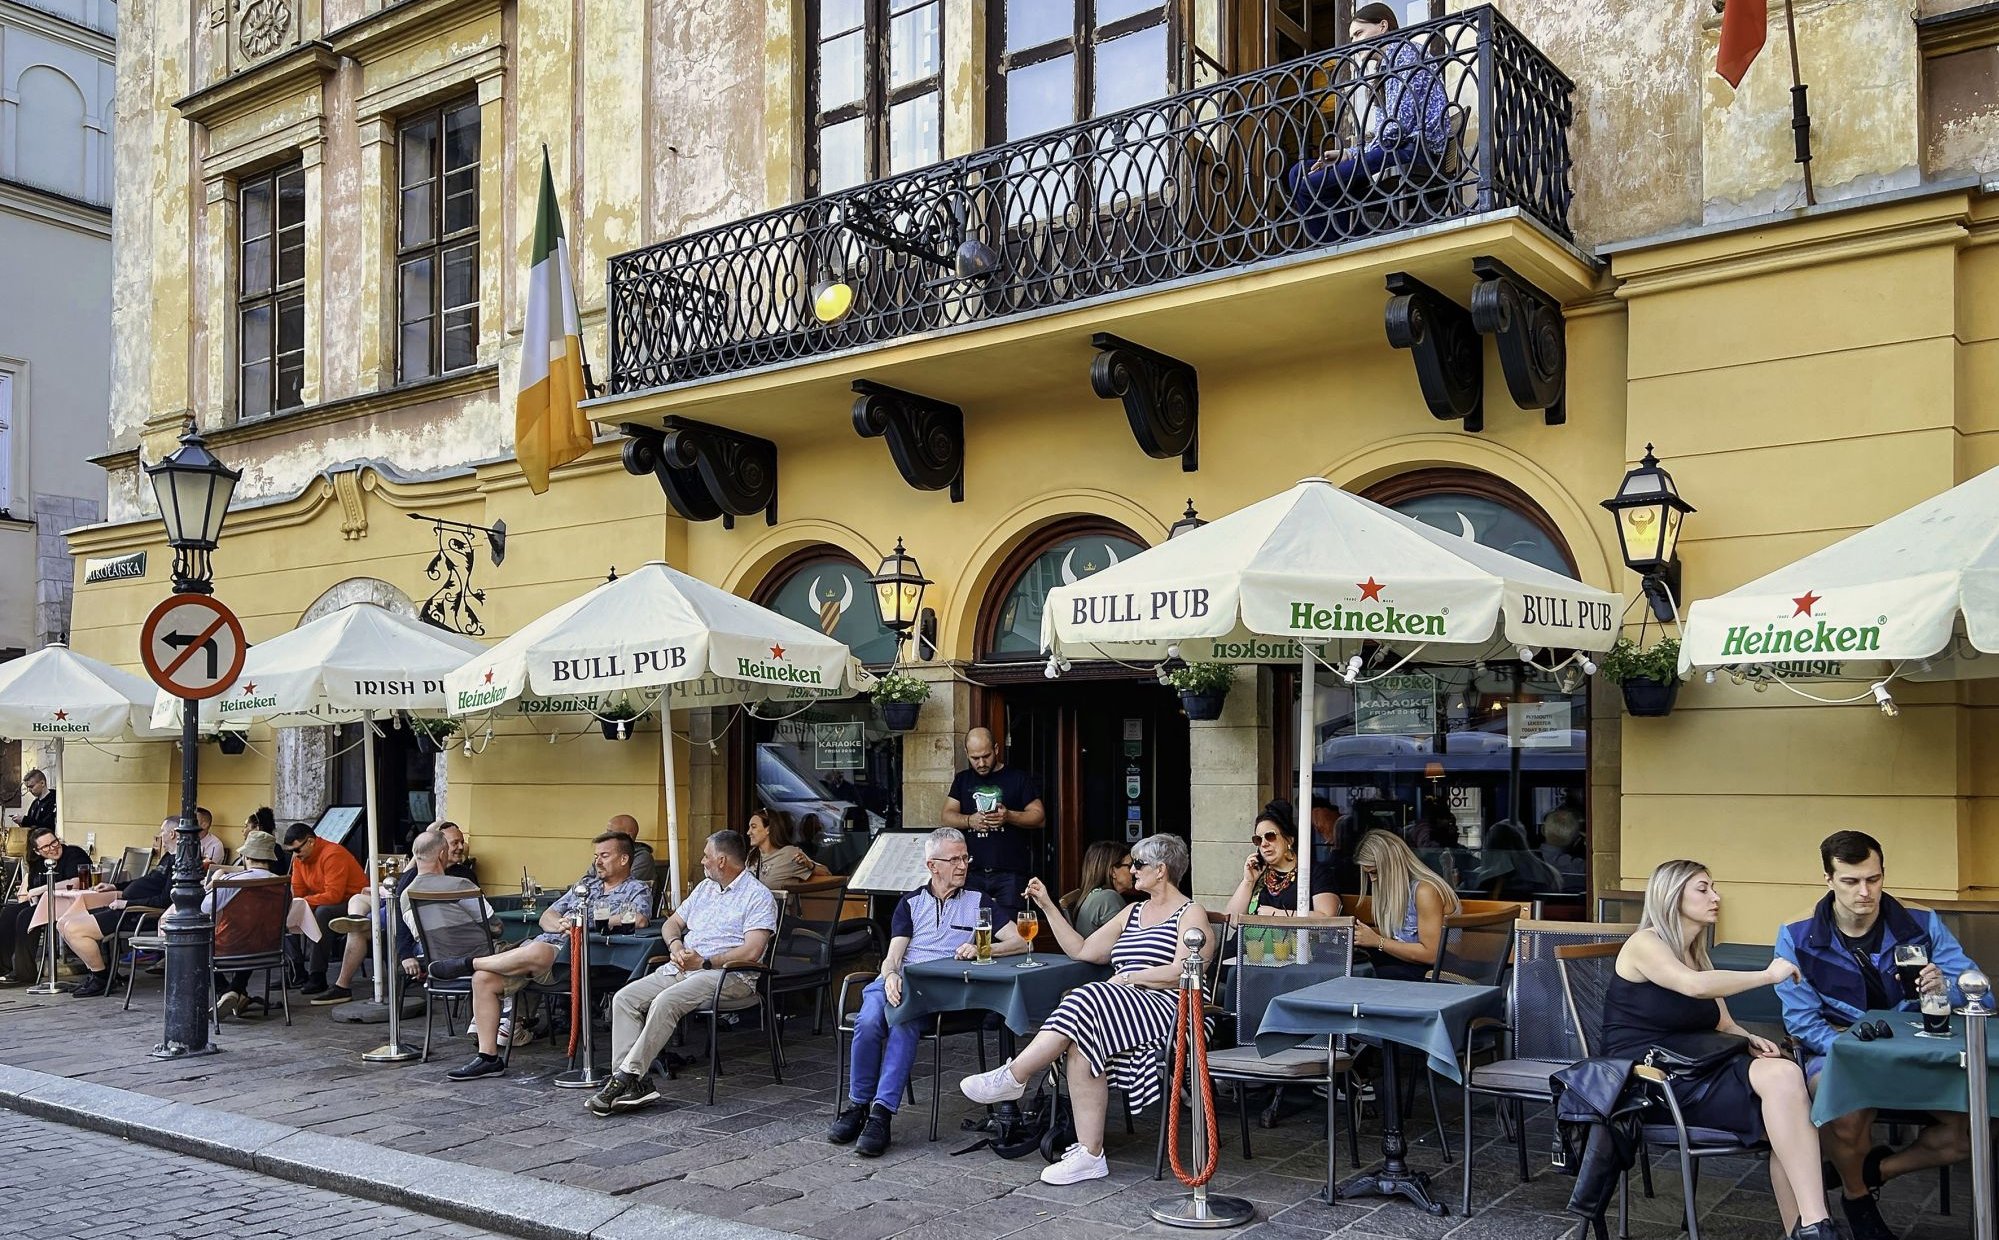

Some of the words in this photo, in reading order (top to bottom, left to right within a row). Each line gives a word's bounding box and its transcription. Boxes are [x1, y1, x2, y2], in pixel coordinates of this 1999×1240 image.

[1071, 593, 1140, 625] BULL
[1150, 588, 1209, 620] PUB
[1289, 602, 1446, 636] Heineken
[1522, 594, 1573, 628] BULL
[1577, 600, 1612, 631] PUB
[1721, 620, 1881, 656] Heineken
[552, 655, 625, 681] BULL
[633, 646, 687, 674] PUB
[737, 657, 822, 684] Heineken
[354, 680, 415, 695] IRISH
[219, 696, 277, 712] Heineken
[1360, 698, 1433, 708] KARAOKE
[32, 722, 90, 732] Heineken
[818, 740, 862, 748] KARAOKE
